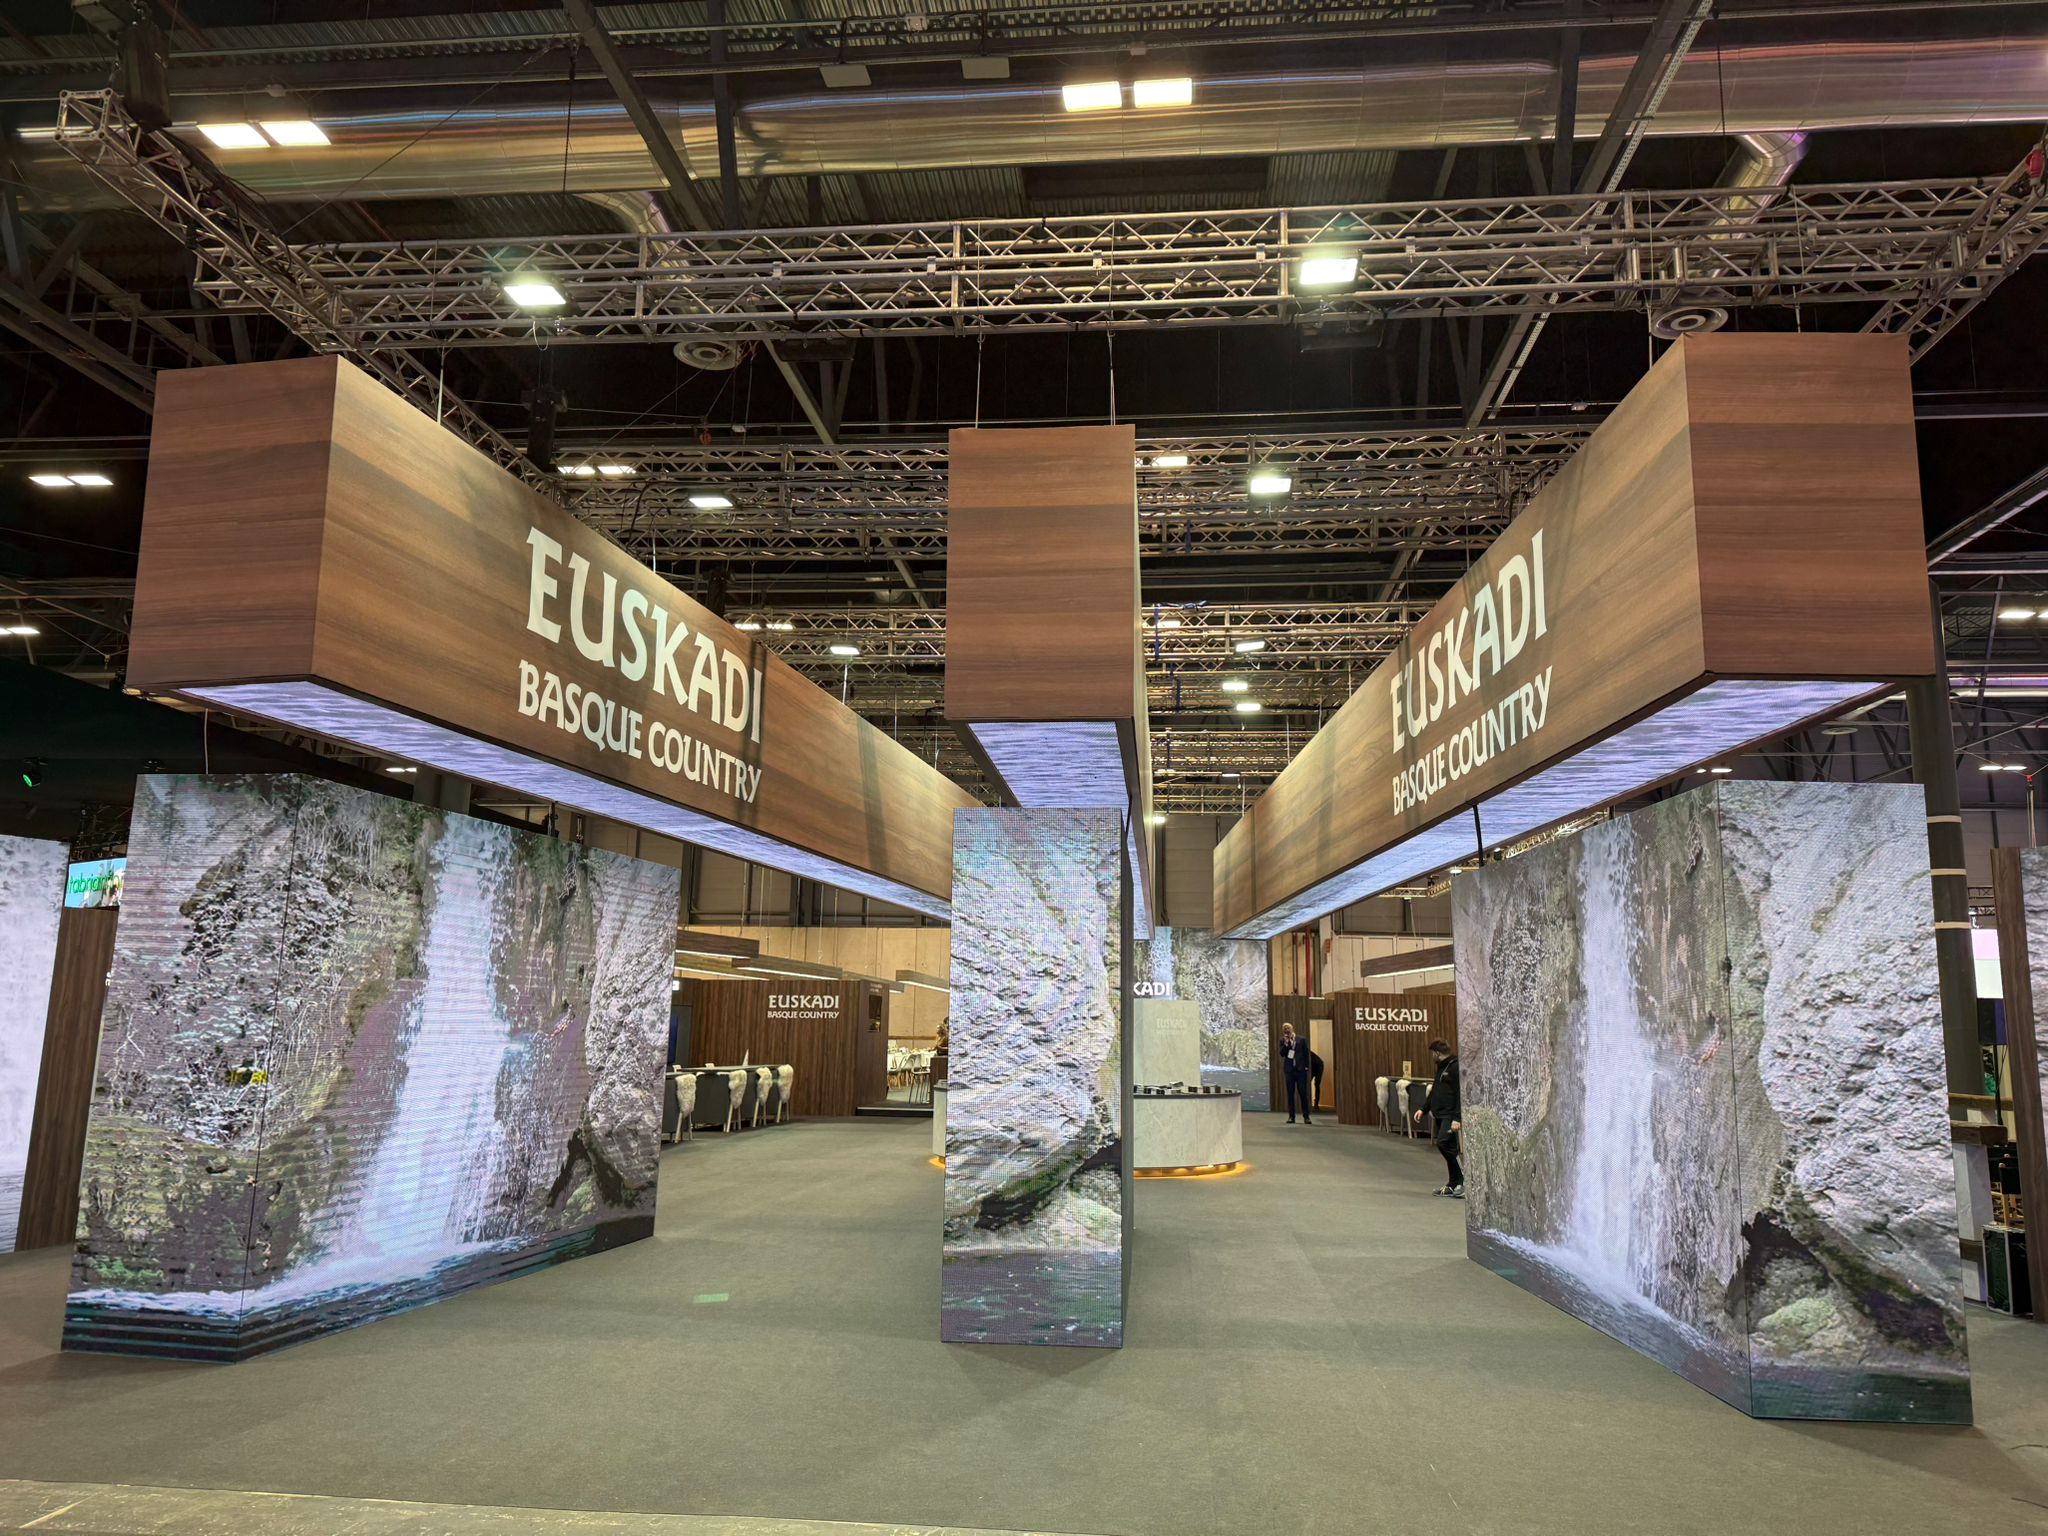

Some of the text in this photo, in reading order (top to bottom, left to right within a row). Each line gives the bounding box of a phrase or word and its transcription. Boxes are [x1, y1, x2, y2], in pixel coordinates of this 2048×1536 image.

[526, 526, 762, 744] EUSKADI
[1390, 528, 1547, 754] EUSKADI
[518, 659, 763, 804] BASQUE COUNTRY
[1392, 665, 1553, 816] BASQUE COUNTRY
[767, 1010, 840, 1019] BASQUE COUNTRY
[768, 994, 840, 1009] EUSKADI
[1354, 1007, 1428, 1022] EUSKADI
[1355, 1022, 1430, 1033] BASQUE COUNTRY
